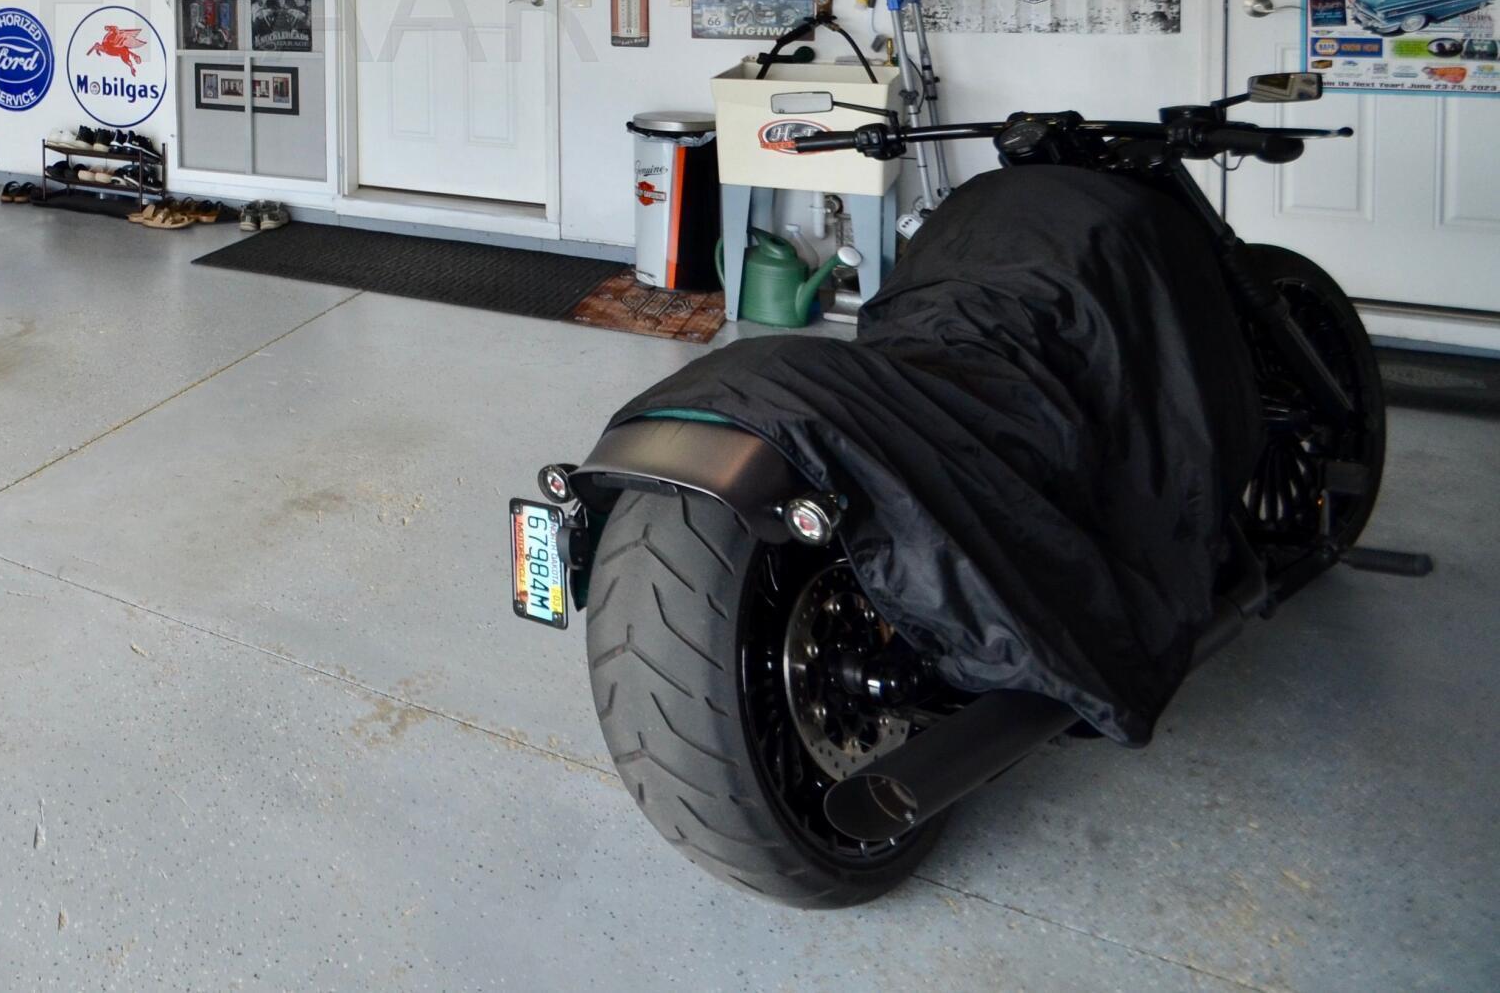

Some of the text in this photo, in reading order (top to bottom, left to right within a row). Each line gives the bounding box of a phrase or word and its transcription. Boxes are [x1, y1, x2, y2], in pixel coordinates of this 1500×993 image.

[707, 17, 721, 27] 66
[728, 26, 796, 37] HIGHWA
[76, 74, 160, 103] Mobilgas
[517, 522, 527, 586] MOTORCYCLE
[528, 515, 550, 611] 67984M
